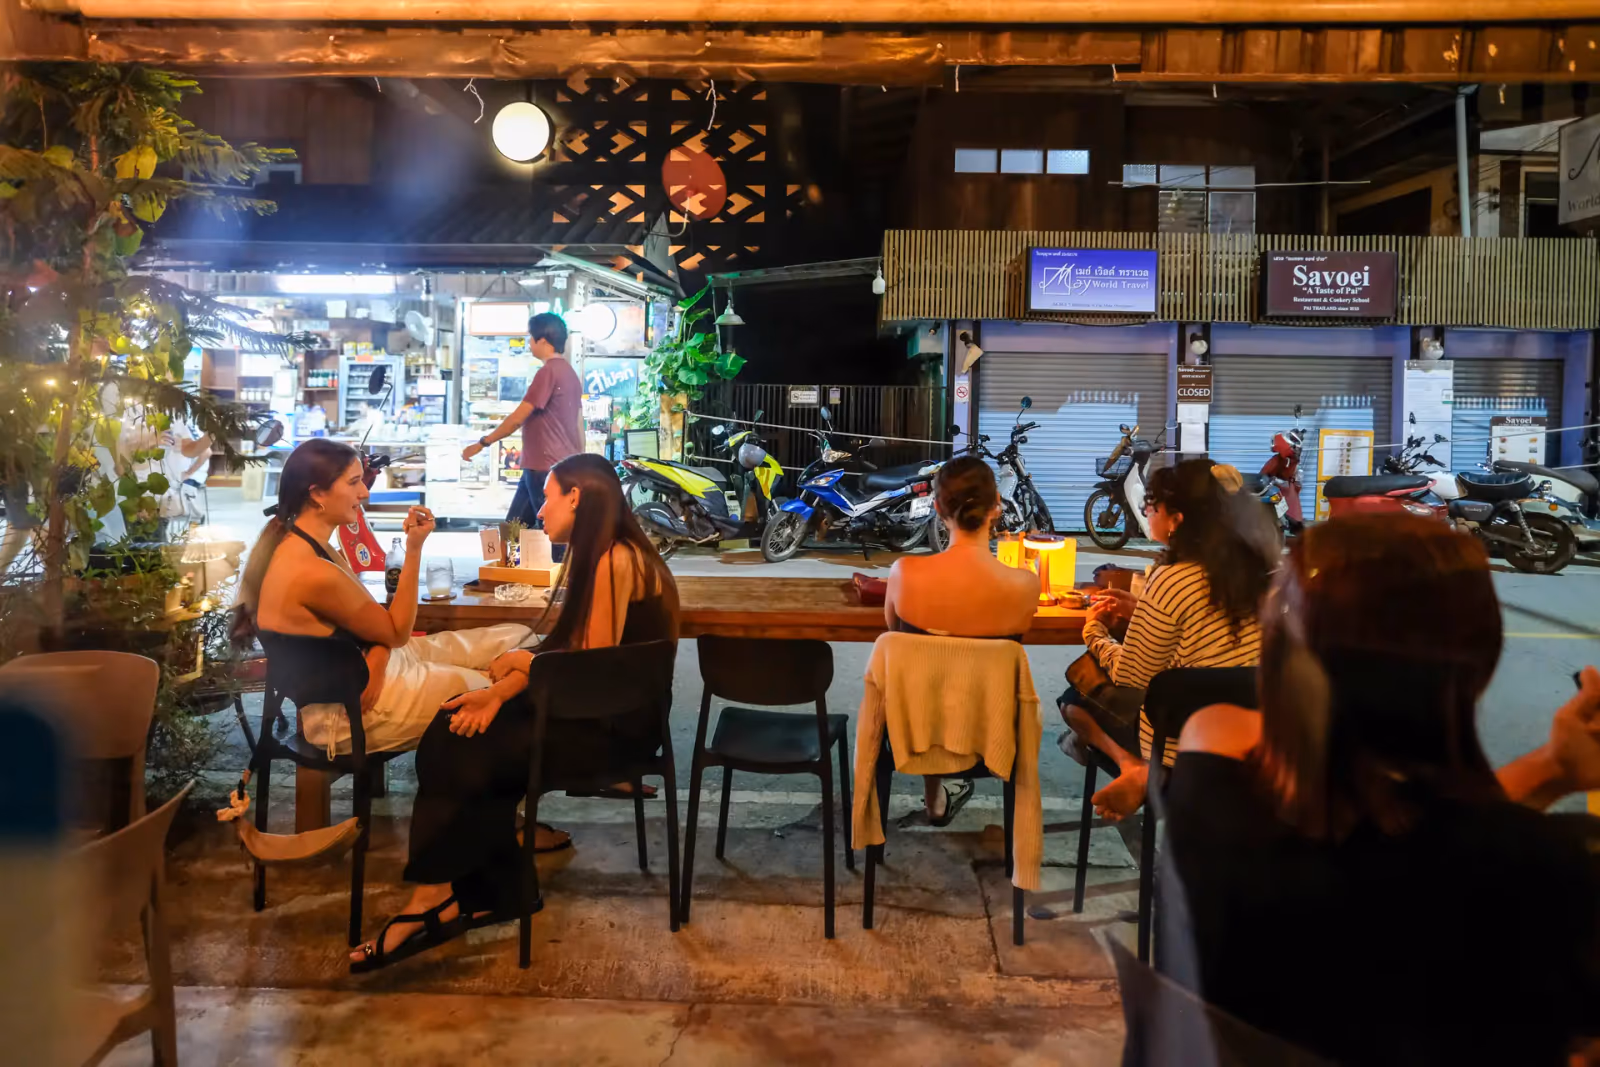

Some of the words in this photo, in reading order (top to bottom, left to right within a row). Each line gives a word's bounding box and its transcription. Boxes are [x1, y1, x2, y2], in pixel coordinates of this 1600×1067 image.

[1293, 264, 1370, 287] Savoei
[1092, 280, 1118, 289] World
[1121, 280, 1149, 289] Travel
[1314, 287, 1335, 295] Taste
[1335, 287, 1344, 295] of
[1177, 387, 1210, 396] CLOSED
[487, 542, 496, 554] 8
[359, 550, 369, 561] 76
